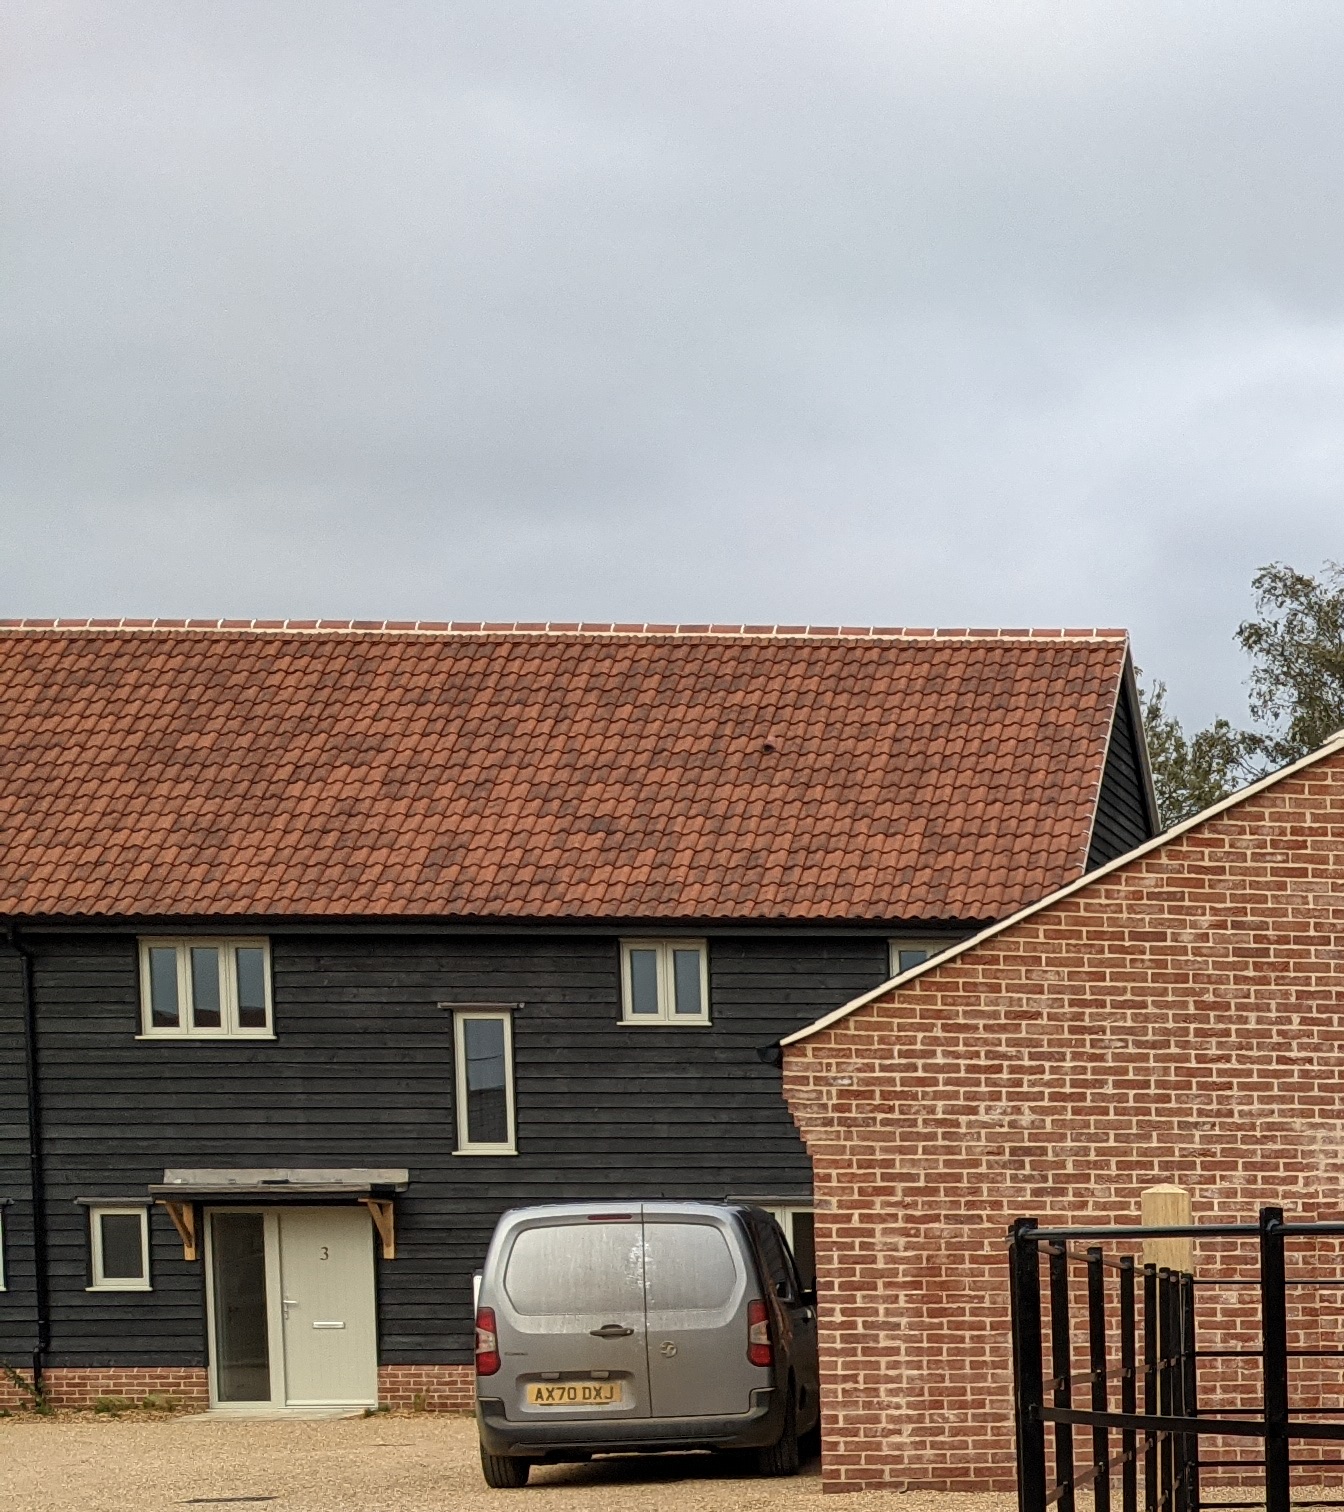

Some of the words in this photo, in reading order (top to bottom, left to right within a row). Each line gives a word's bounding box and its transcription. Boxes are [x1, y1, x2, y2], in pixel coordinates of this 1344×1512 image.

[320, 1246, 329, 1261] 3
[534, 1386, 577, 1402] AX70
[582, 1385, 614, 1400] DXJ
